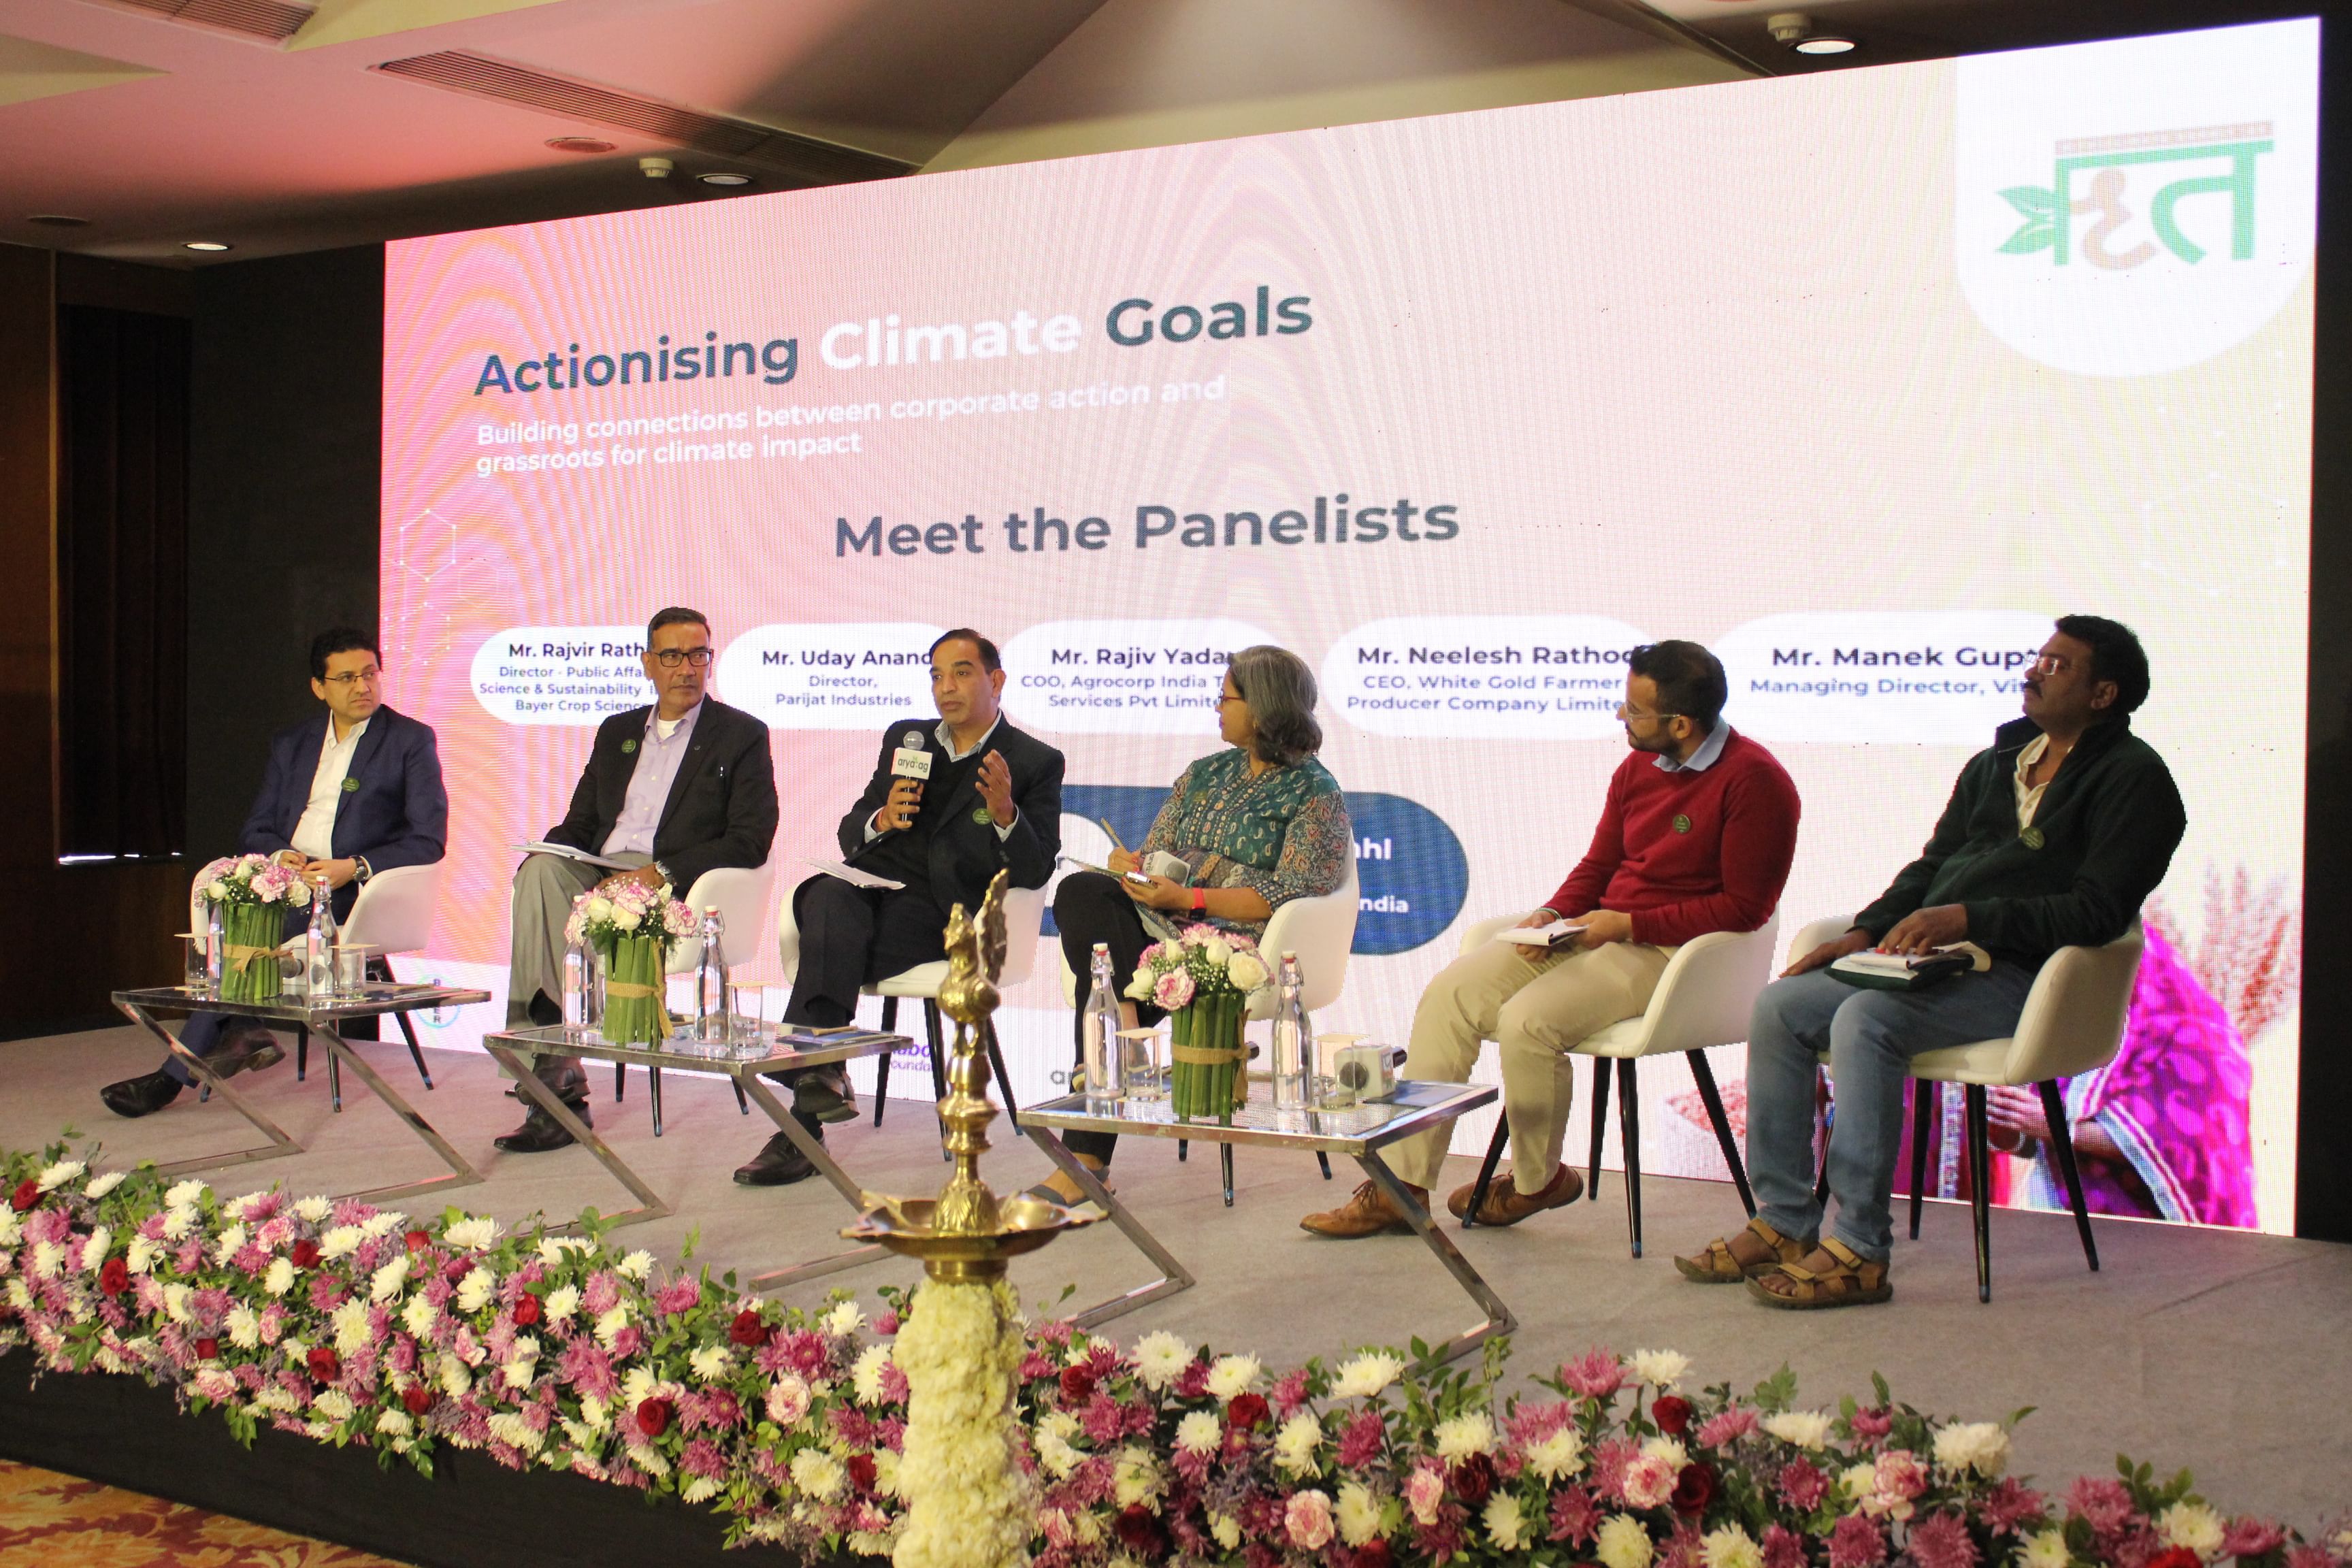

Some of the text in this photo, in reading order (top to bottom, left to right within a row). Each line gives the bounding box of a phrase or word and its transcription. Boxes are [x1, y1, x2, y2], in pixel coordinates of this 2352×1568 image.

[474, 285, 1313, 396] Actionising Climate Goals
[477, 374, 1226, 445] Building connections between corporate action and
[476, 432, 862, 478] grassroots for climate impact
[835, 493, 1460, 557] Meet the Panelists
[508, 642, 644, 661] Mr. Rajvir Rath
[763, 651, 794, 666] Mr.
[802, 650, 855, 669] Uday
[1052, 647, 1229, 669] Mr. Rajiv Yada
[1358, 647, 1399, 664] Mr.
[1409, 646, 1522, 664] Neelesh
[1772, 648, 1821, 666] Mr.
[1833, 647, 1943, 666] Manek
[500, 666, 554, 678] Director
[567, 666, 610, 678] Public
[614, 666, 644, 678] Affa
[479, 683, 530, 694] Science
[535, 684, 544, 695] &
[547, 683, 642, 698] Sustainability
[808, 675, 878, 689] Director,
[1021, 674, 1066, 690] COO,
[1071, 674, 1156, 691] Agrocorp
[1161, 674, 1207, 688] India
[1363, 674, 1622, 690] CEO, White Gold Farmer
[1750, 678, 1869, 697] Managing
[1878, 678, 1985, 697] Director,
[515, 700, 553, 713] Bayer
[558, 700, 591, 713] Crop
[776, 693, 912, 708] Parijat Industries
[1049, 694, 1123, 708] Services
[1128, 695, 1158, 708] Pvt
[1348, 696, 1441, 710] Producer
[1448, 696, 1549, 713] Company
[1359, 894, 1409, 913] ndia
